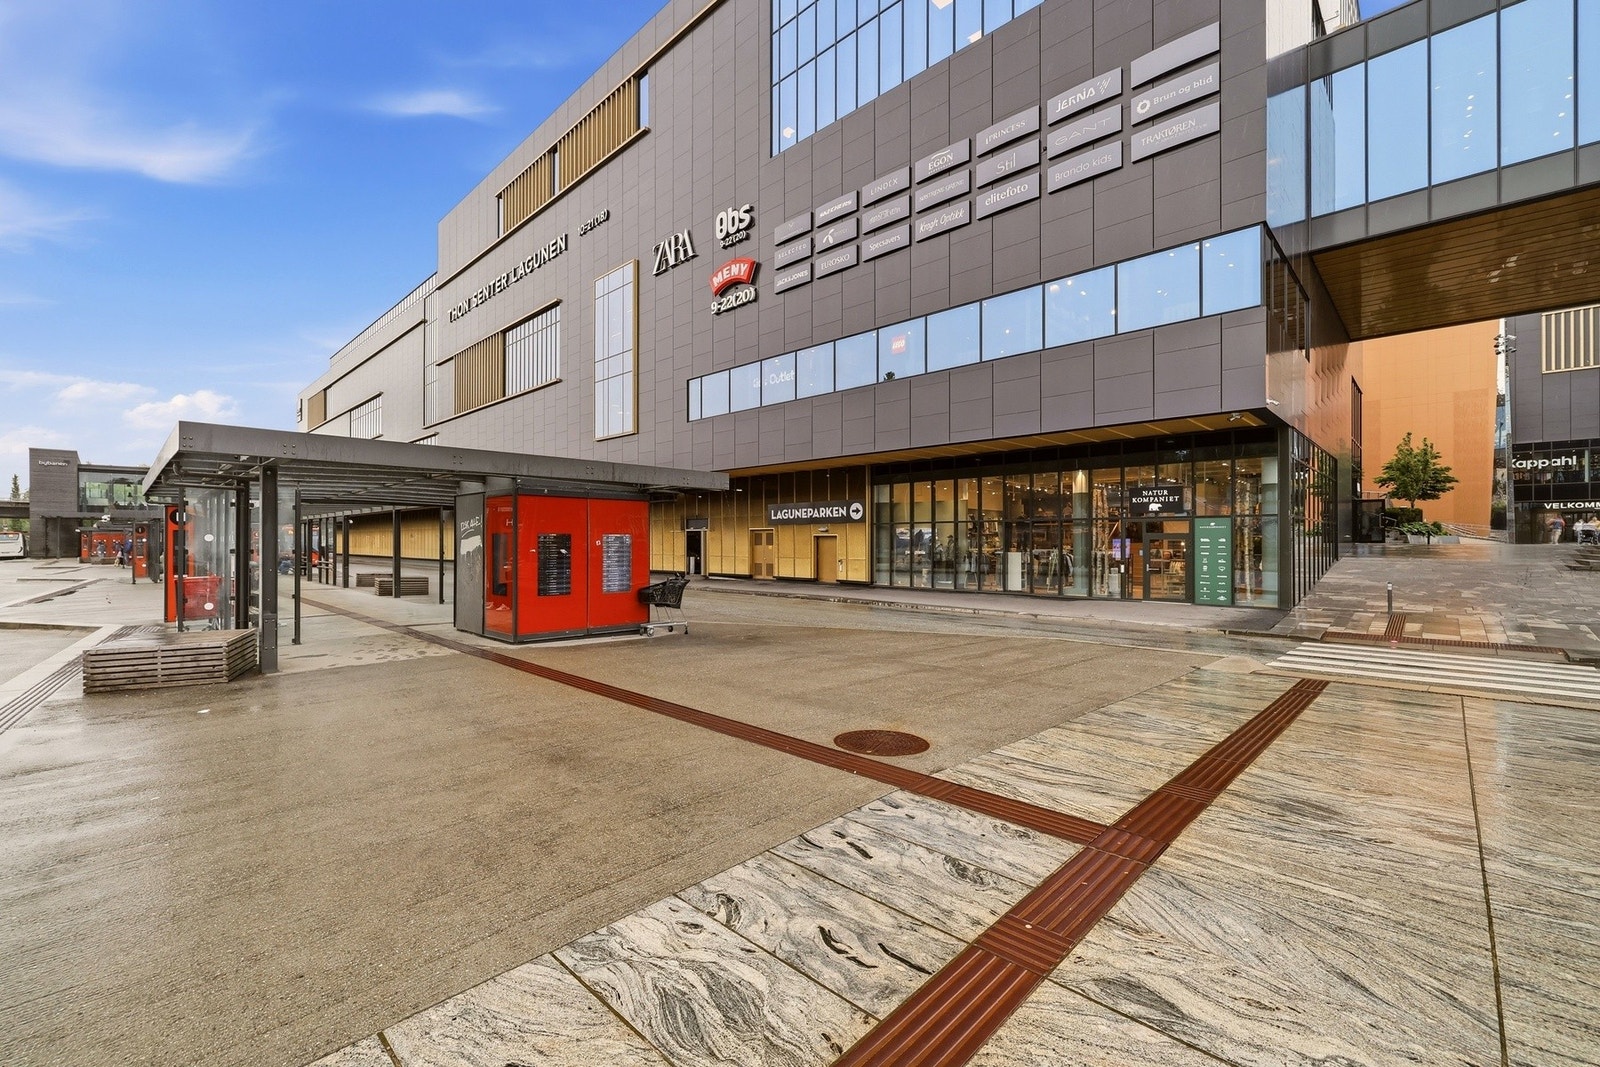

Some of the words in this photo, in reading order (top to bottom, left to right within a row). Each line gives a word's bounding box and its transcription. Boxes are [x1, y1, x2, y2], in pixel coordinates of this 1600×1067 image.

[1153, 91, 1176, 105] Brun
[1178, 85, 1191, 94] og
[1193, 75, 1213, 88] blid
[1055, 117, 1111, 146] GANT
[1142, 118, 1196, 146] TRAKTØREN
[928, 152, 954, 171] EGON
[996, 152, 1016, 175] Stil
[1055, 162, 1090, 182] Brando
[1092, 154, 1112, 168] kids
[869, 177, 898, 196] LINDEX
[984, 183, 1029, 206] elitefoto
[652, 228, 696, 276] ZARA
[869, 234, 901, 251] Specsavers
[820, 253, 850, 270] EUROSKO
[448, 297, 470, 321] THON
[472, 272, 508, 308] SENTER
[512, 233, 567, 283] LAGUNEN
[712, 262, 749, 287] MENY
[710, 286, 756, 315] 9-22(20)
[769, 369, 795, 385] Outlet
[1132, 495, 1180, 503] KOMPANIET
[771, 506, 847, 520] LAGUNEPARKEN
